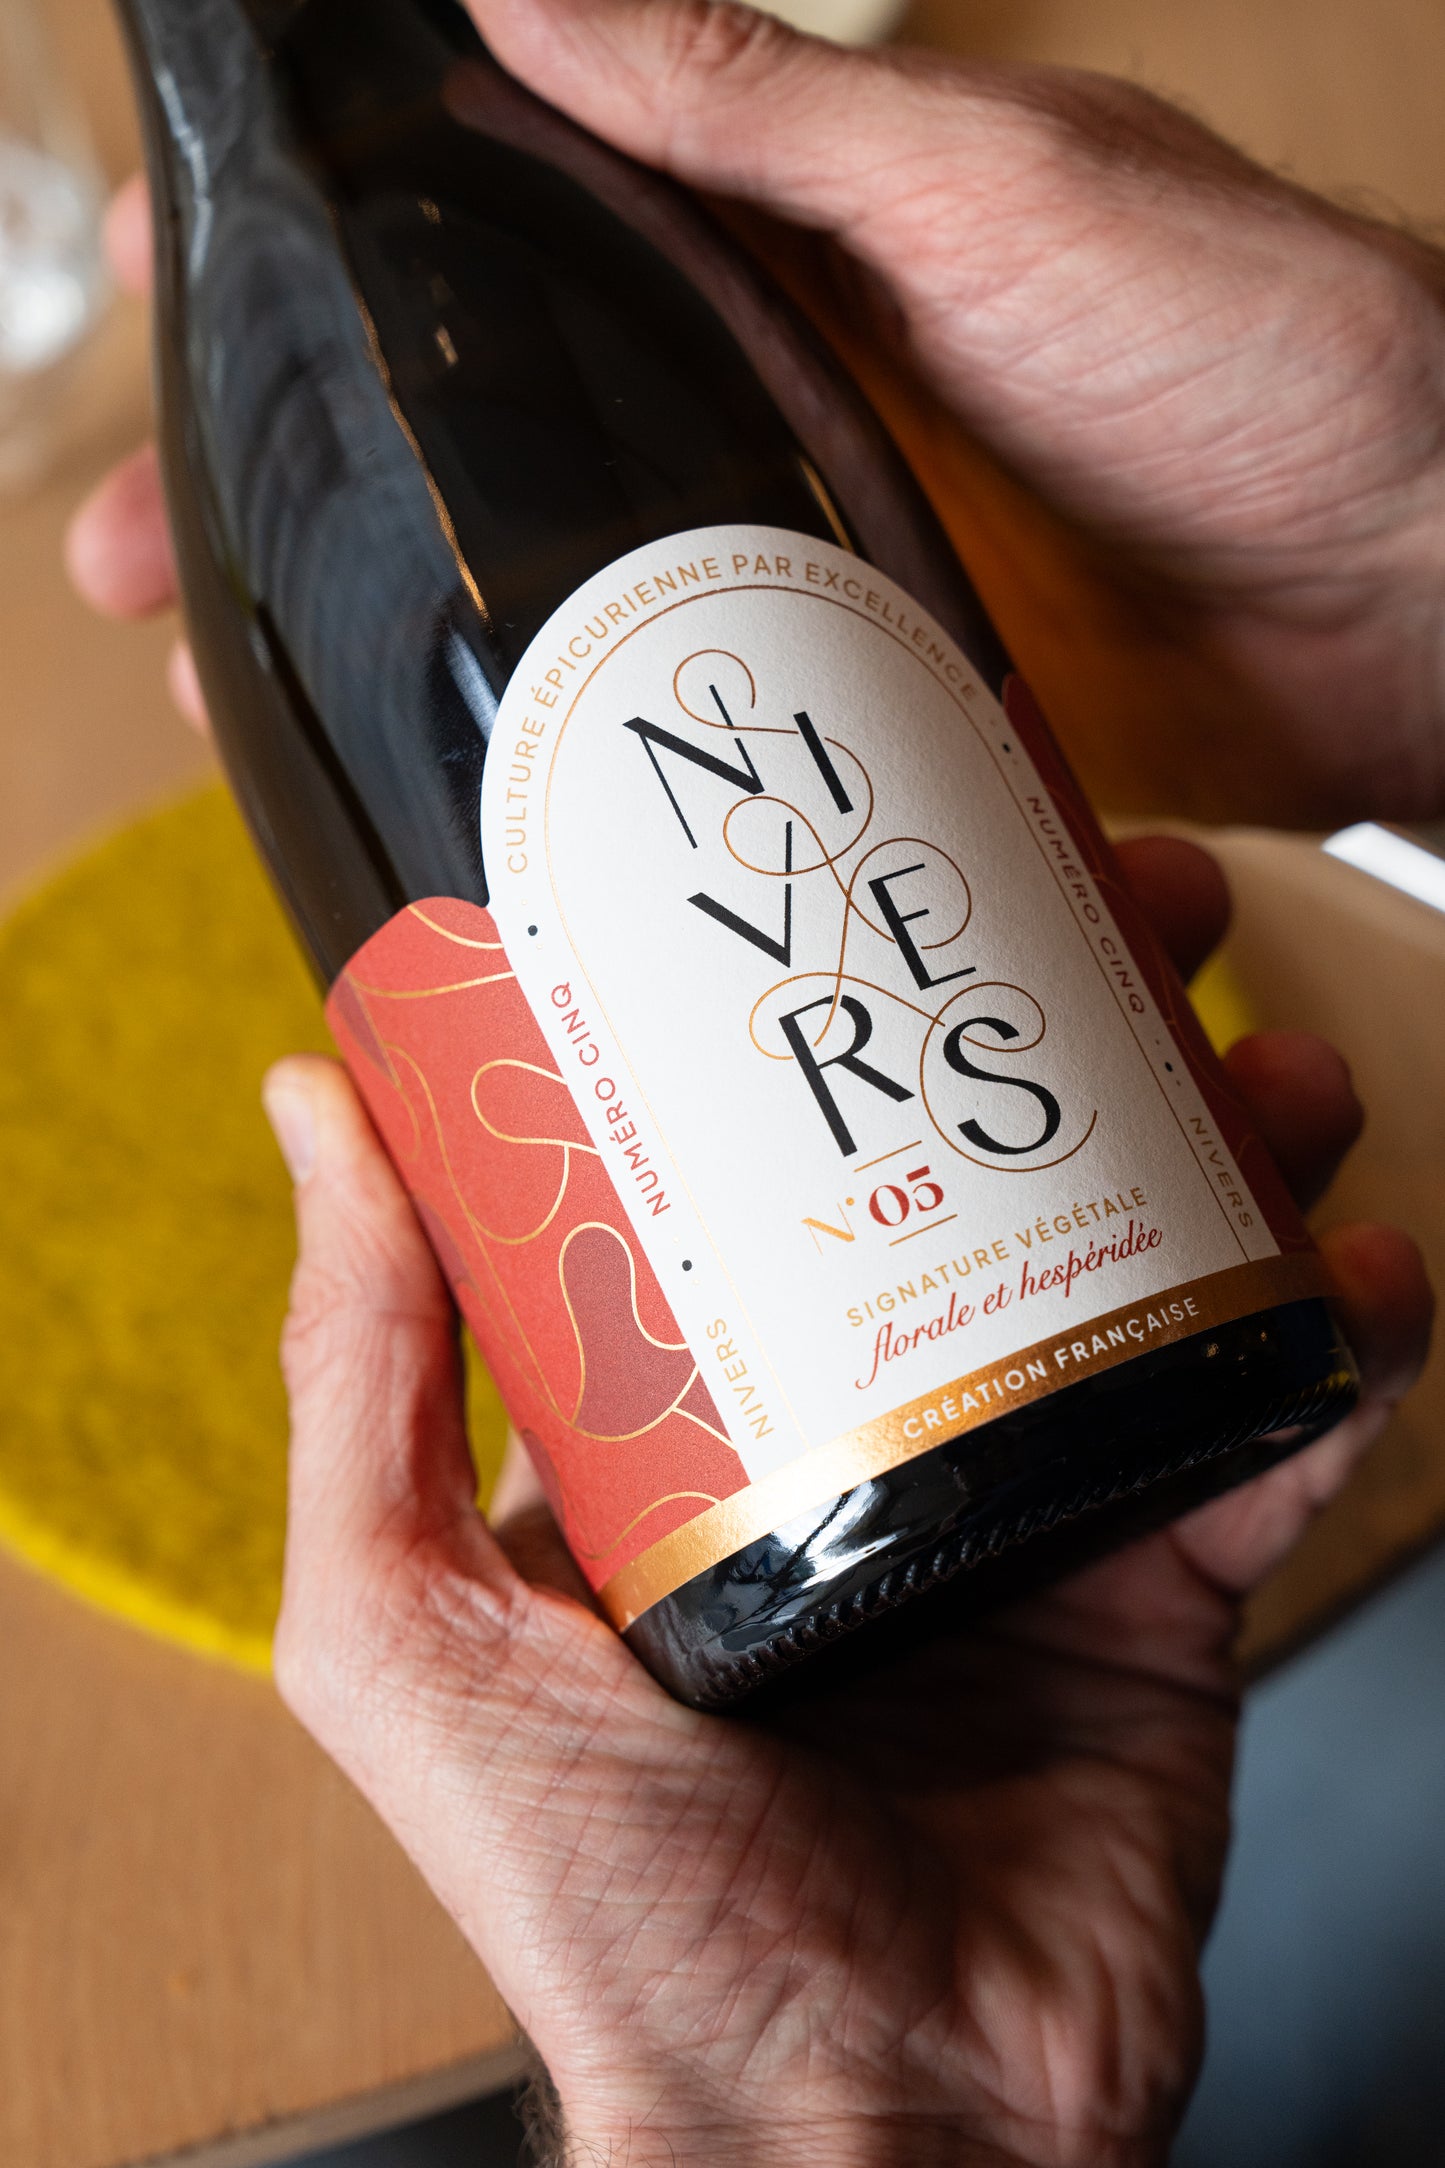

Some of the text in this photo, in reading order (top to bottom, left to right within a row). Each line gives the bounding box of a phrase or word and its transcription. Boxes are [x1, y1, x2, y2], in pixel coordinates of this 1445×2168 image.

[504, 553, 980, 875] CULTURE ÉPICURIENNE PAR EXCELLENCE
[1026, 796, 1145, 1016] NUMÉRO CINQ
[549, 981, 671, 1217] NUMÉRO CINQ
[1188, 1116, 1254, 1230] NIVERS
[845, 1186, 1148, 1328] SIGNATURE VÉGÉTALE
[854, 1220, 1164, 1391] florale et hespéridée
[706, 1317, 775, 1441] NIVERS
[902, 1297, 1200, 1440] CRÉATION FRANÇAISE
